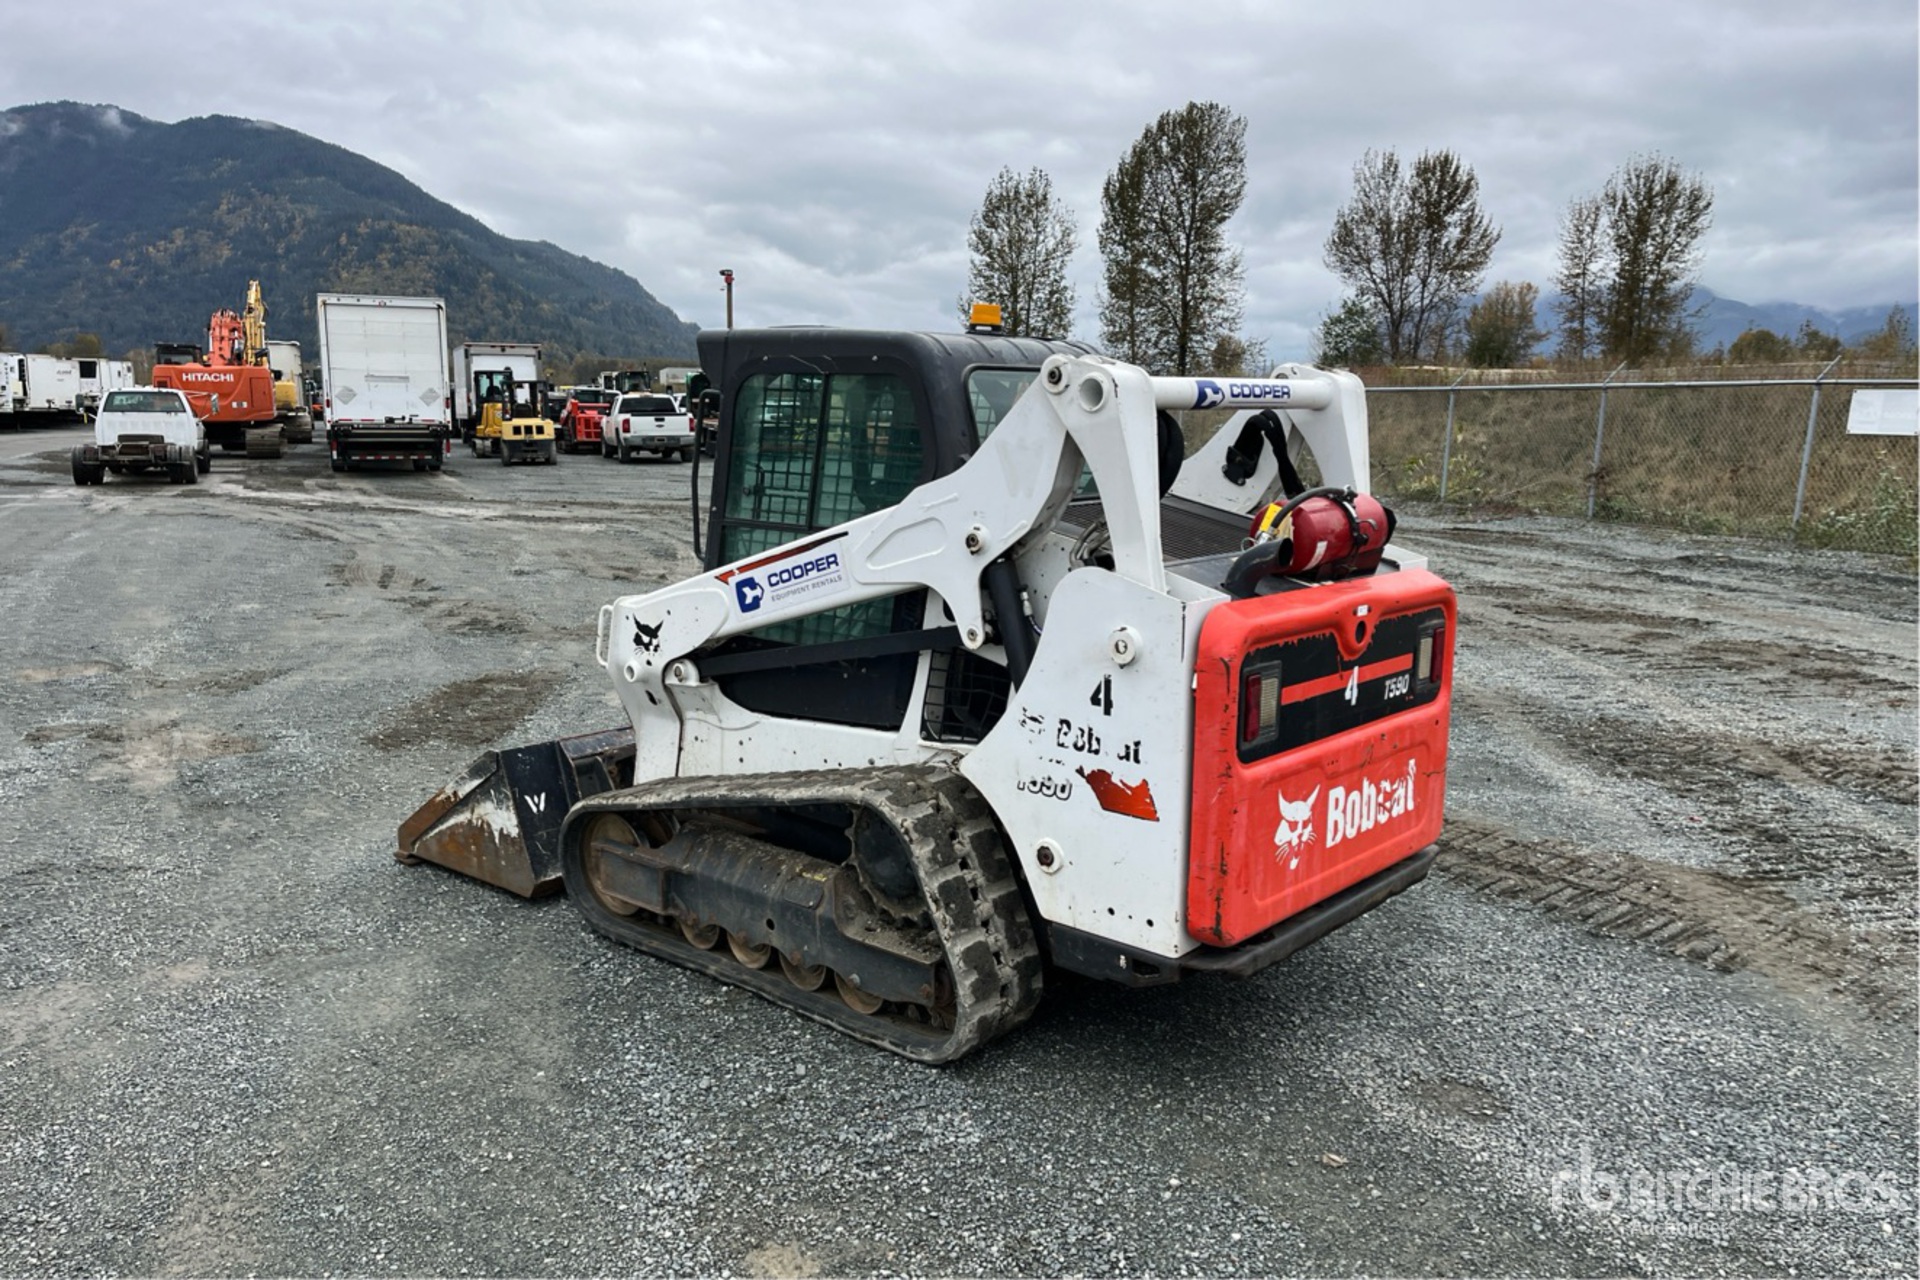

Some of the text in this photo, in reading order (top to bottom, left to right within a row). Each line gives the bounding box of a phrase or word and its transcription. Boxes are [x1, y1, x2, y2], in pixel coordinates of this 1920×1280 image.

[182, 372, 234, 383] HITACHI
[1229, 383, 1291, 399] COOPER
[768, 553, 839, 586] COOPER
[772, 575, 842, 601] EQUIPMENT RENTALS
[1090, 674, 1114, 716] 4
[1344, 665, 1359, 706] 4
[1384, 674, 1410, 700] T590
